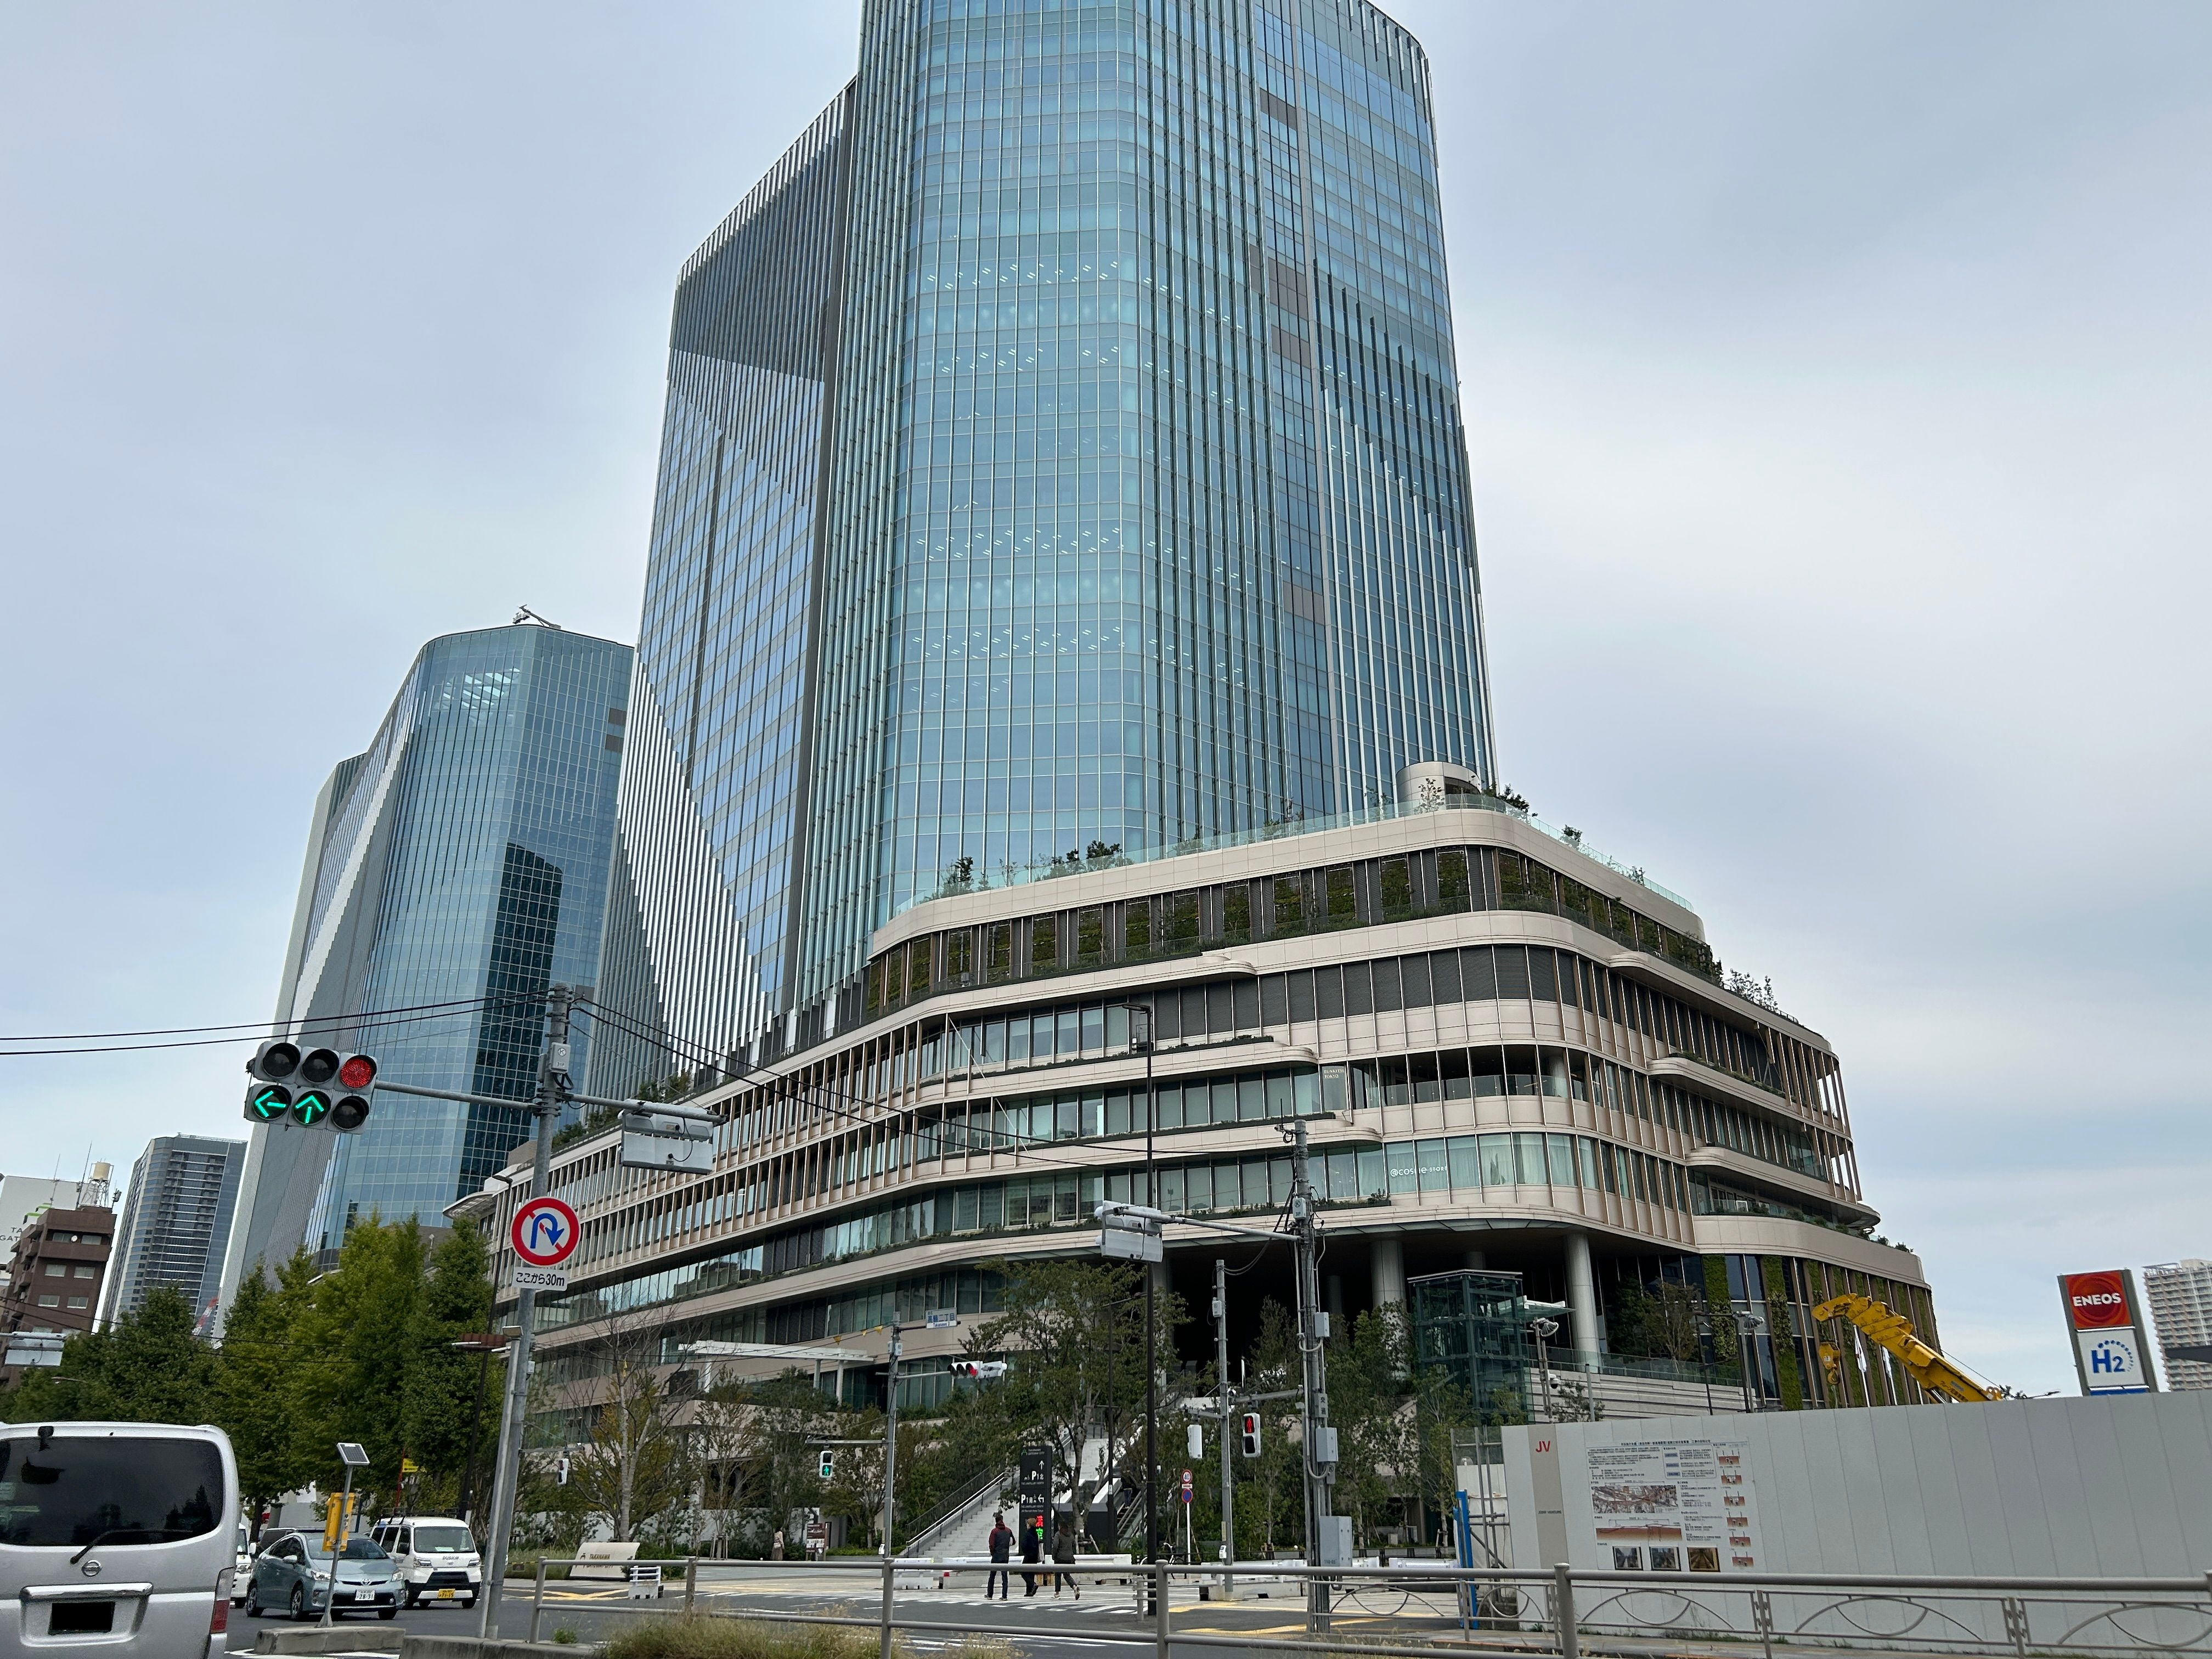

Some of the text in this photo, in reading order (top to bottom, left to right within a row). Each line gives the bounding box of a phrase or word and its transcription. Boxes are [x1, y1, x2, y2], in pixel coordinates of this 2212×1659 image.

[516, 1272, 565, 1286] ここから30m
[2072, 1292, 2121, 1307] ENEOS
[2091, 1349, 2125, 1374] H2
[1321, 1397, 1326, 1415] 交通
[1536, 1440, 1551, 1453] JV
